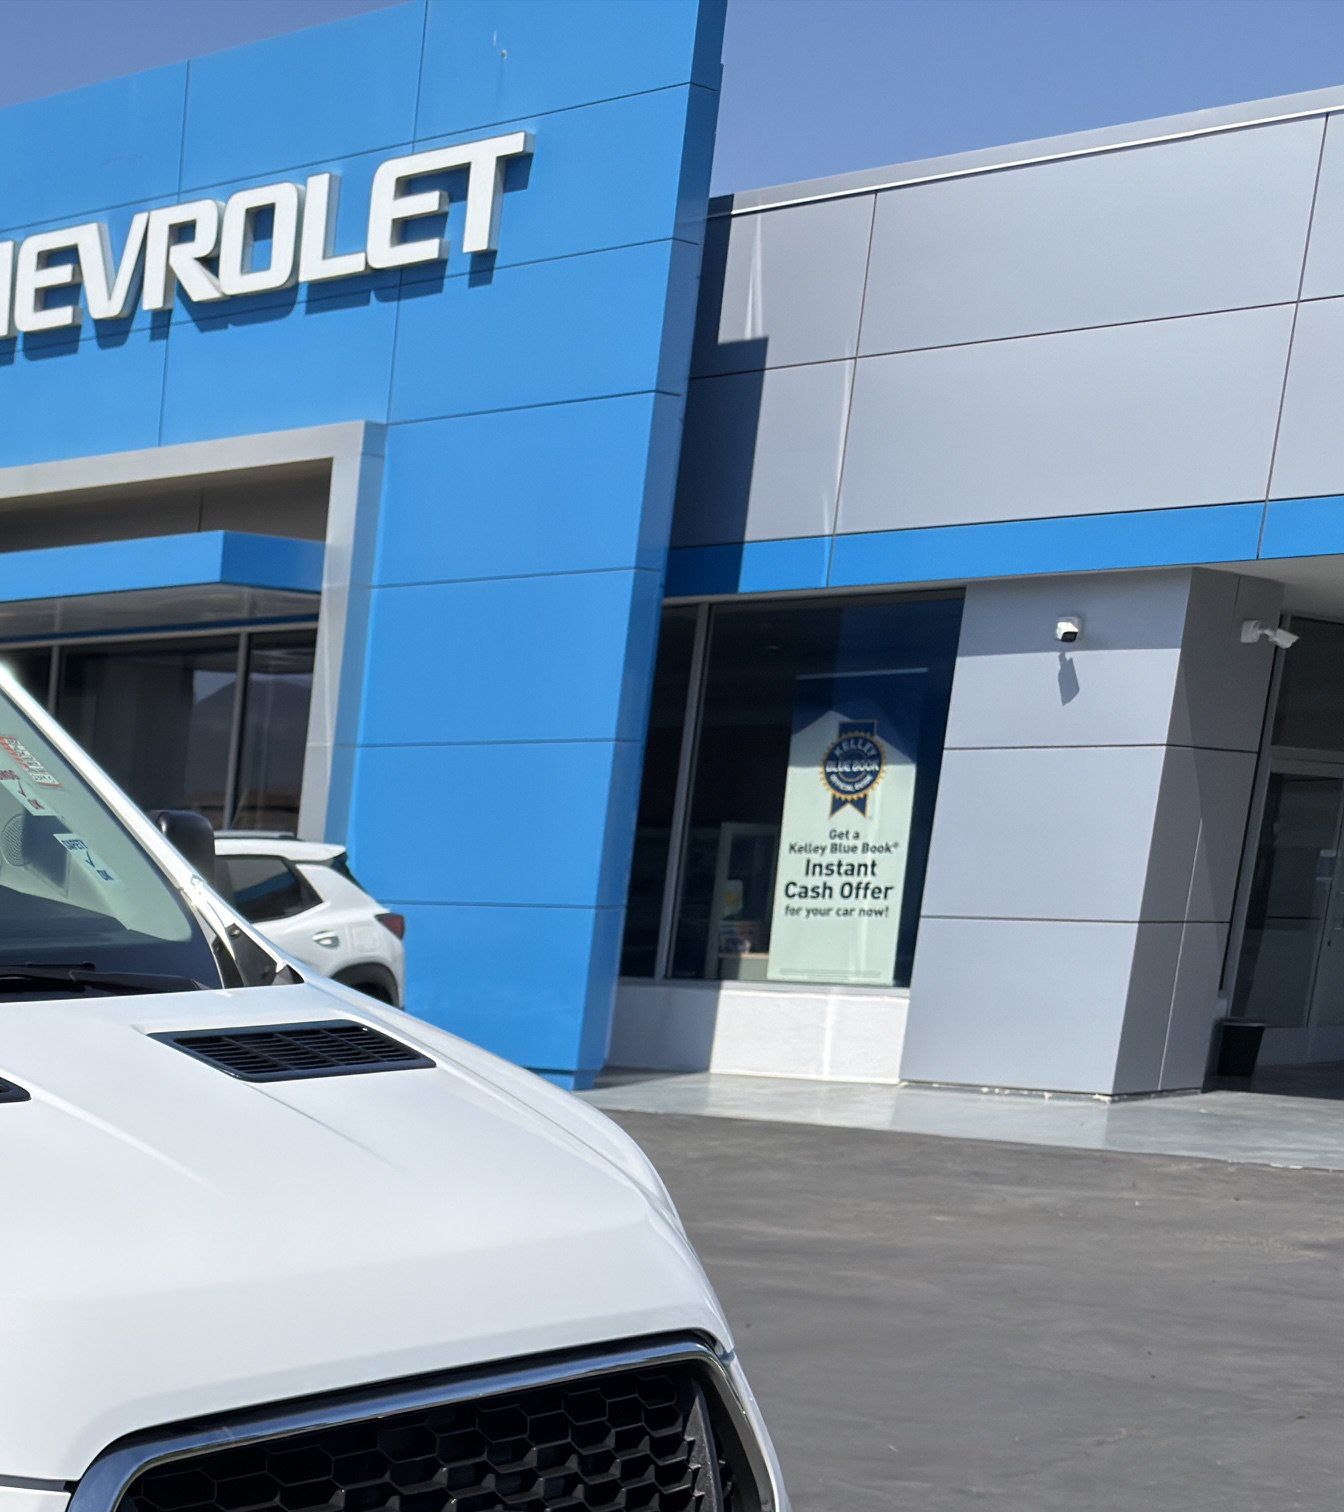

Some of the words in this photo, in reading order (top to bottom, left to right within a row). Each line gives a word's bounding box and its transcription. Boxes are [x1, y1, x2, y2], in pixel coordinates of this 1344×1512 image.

[829, 829, 849, 840] Get
[852, 831, 860, 840] a
[789, 842, 827, 856] Kelley
[830, 842, 858, 854] Blue
[805, 858, 877, 877] Instant
[785, 881, 832, 899] Cash
[840, 881, 894, 899] Offer
[785, 904, 802, 916] for
[805, 906, 832, 918] your
[835, 907, 857, 917] car
[858, 906, 890, 917] now!
